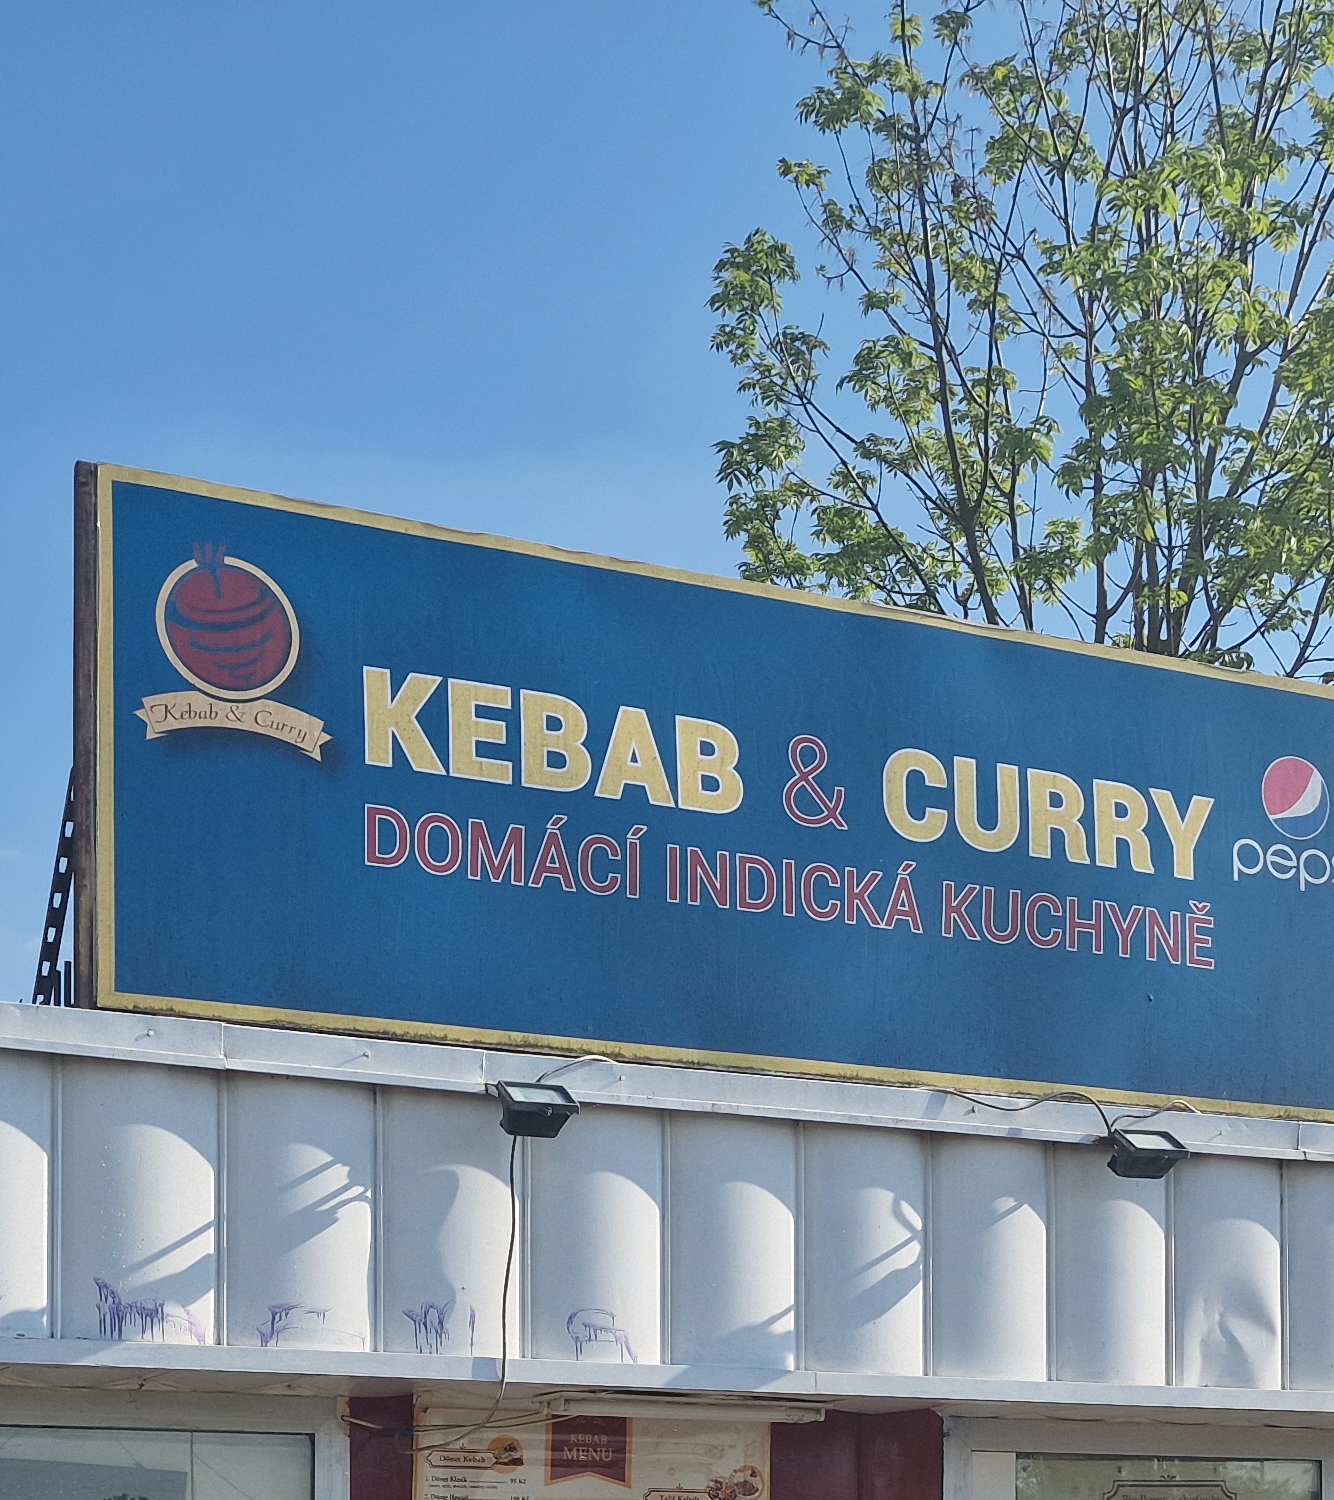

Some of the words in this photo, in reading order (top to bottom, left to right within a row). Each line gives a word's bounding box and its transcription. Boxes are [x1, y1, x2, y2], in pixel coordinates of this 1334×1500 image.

[152, 702, 219, 725] Kebab
[226, 703, 246, 723] &
[253, 708, 309, 745] Curry
[362, 666, 744, 814] KEBAB
[783, 734, 848, 830] &
[882, 748, 1215, 880] CURRY
[364, 804, 647, 898] DOMÁCÍ
[666, 842, 923, 934] INDICKÁ
[941, 880, 1216, 970] KUCHYNĚ
[563, 1447, 613, 1461] MENU
[570, 1434, 608, 1444] KEBAB
